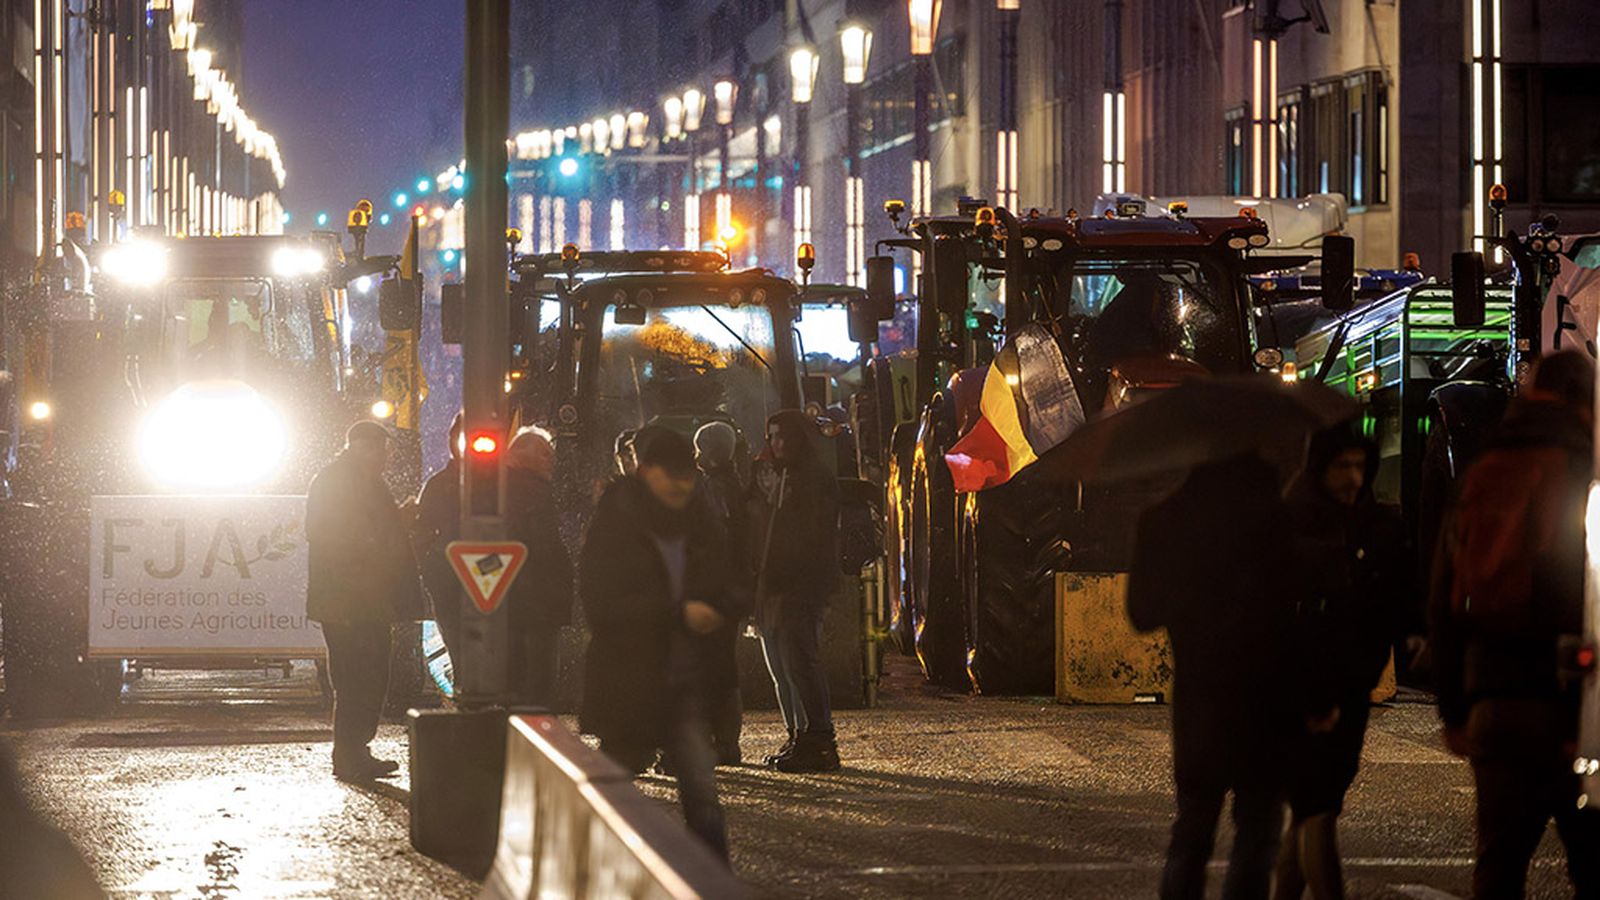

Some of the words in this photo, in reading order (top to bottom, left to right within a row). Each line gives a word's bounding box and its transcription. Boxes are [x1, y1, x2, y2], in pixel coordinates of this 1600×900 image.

[103, 518, 252, 580] FJA
[102, 588, 219, 607] Fédération
[227, 588, 266, 607] des
[102, 610, 184, 630] Jeunes
